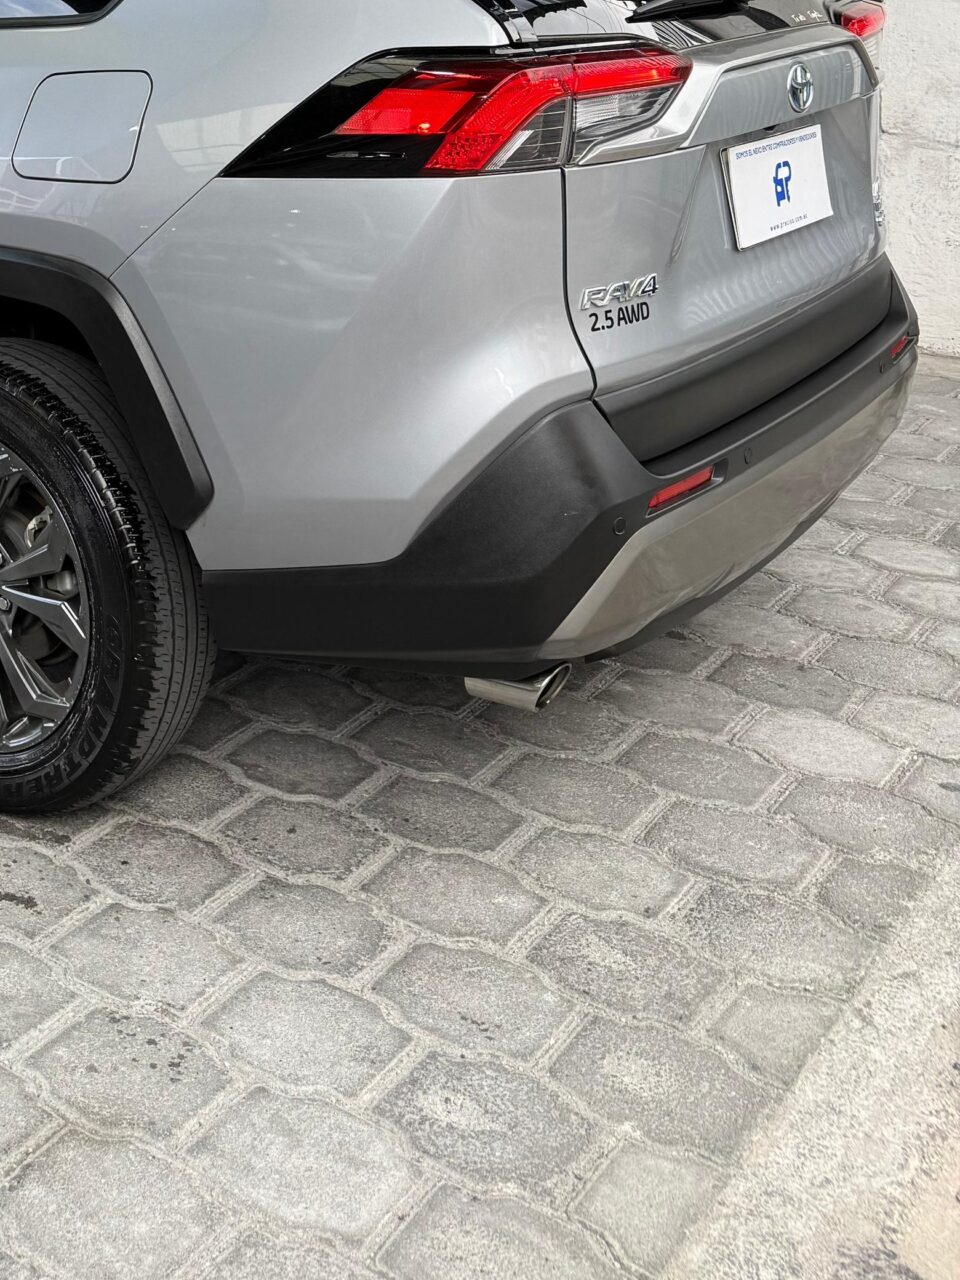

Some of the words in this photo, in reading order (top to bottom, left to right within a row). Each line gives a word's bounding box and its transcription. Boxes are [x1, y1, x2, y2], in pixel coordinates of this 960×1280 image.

[579, 273, 659, 310] RAV4
[589, 309, 614, 332] 2.5
[617, 301, 650, 327] AWD
